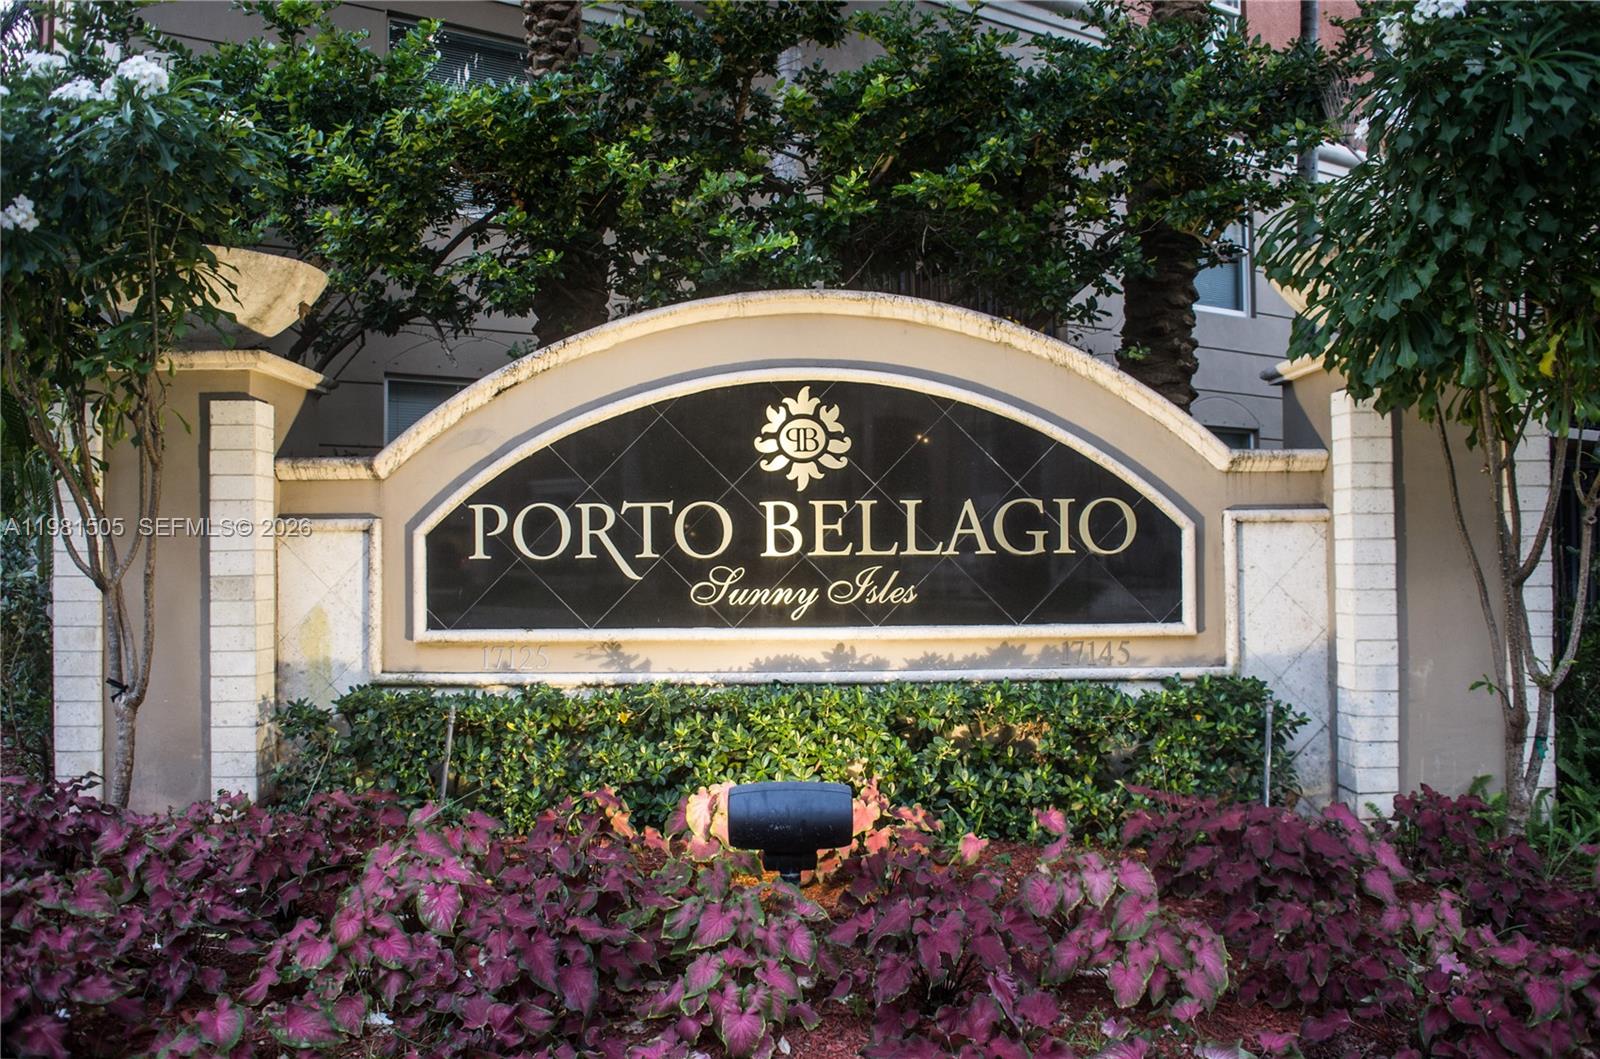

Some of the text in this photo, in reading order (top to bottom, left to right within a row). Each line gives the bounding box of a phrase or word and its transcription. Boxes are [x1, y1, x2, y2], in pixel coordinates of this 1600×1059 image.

[468, 497, 1138, 580] PORTO BELLAGIO
[690, 565, 918, 621] Sunny Isles
[482, 643, 550, 671] 17125
[1060, 639, 1131, 667] 17145
